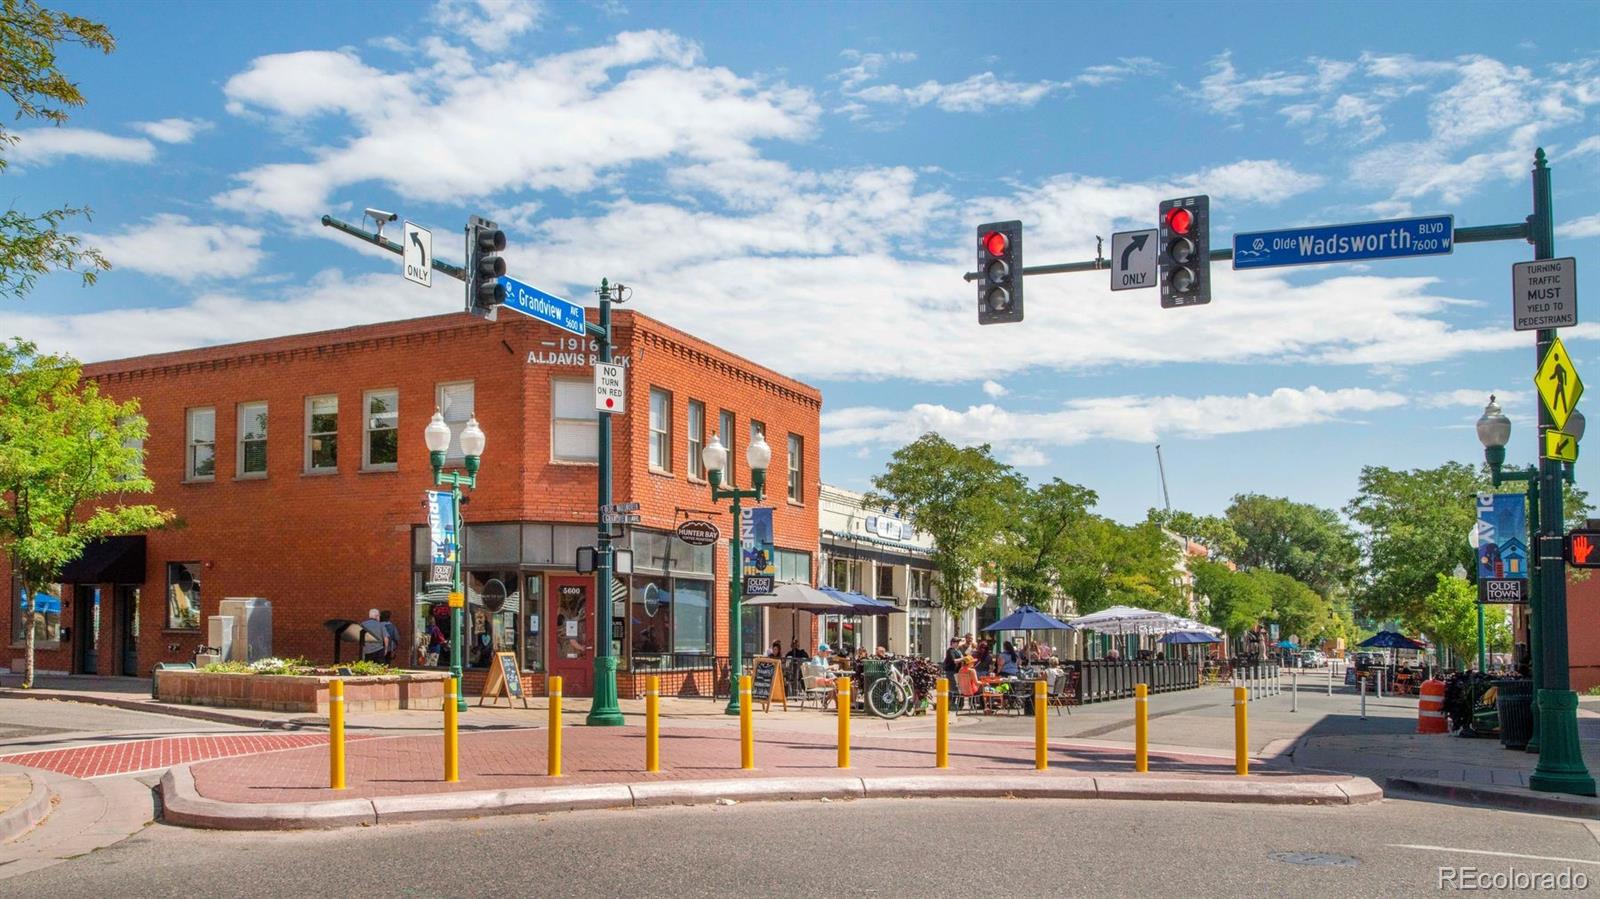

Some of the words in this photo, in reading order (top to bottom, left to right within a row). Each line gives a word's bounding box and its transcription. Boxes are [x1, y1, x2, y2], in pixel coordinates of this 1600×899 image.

[1419, 222, 1444, 235] BLVD
[1273, 238, 1297, 250] Olde
[1298, 228, 1411, 257] Wadsworth
[1412, 238, 1438, 251] 7600
[1442, 238, 1450, 249] W
[408, 264, 428, 281] ONLY
[1527, 263, 1562, 274] TURNING
[1122, 272, 1147, 286] ONLY
[1528, 275, 1561, 286] TRAFFIC
[1527, 288, 1561, 301] MUST
[519, 288, 562, 320] Grandview
[1527, 303, 1550, 313] YIELD
[1553, 302, 1563, 311] TO
[570, 306, 579, 317] AVE
[565, 317, 578, 331] 5600
[1518, 313, 1573, 326] PEDESTRIANS
[560, 338, 599, 352] 1916
[589, 354, 630, 368] BCK
[603, 367, 617, 377] NO
[602, 378, 619, 388] TURN
[598, 387, 607, 396] ON
[609, 388, 623, 398] RED
[1477, 491, 1495, 543] PLAY
[678, 529, 705, 538] HUNTER
[705, 531, 718, 539] BAY
[741, 509, 755, 551] DINE
[562, 587, 581, 595] 5600
[749, 586, 769, 594] TOWN
[1490, 582, 1517, 591] OLDE
[1489, 590, 1519, 599] TOWN
